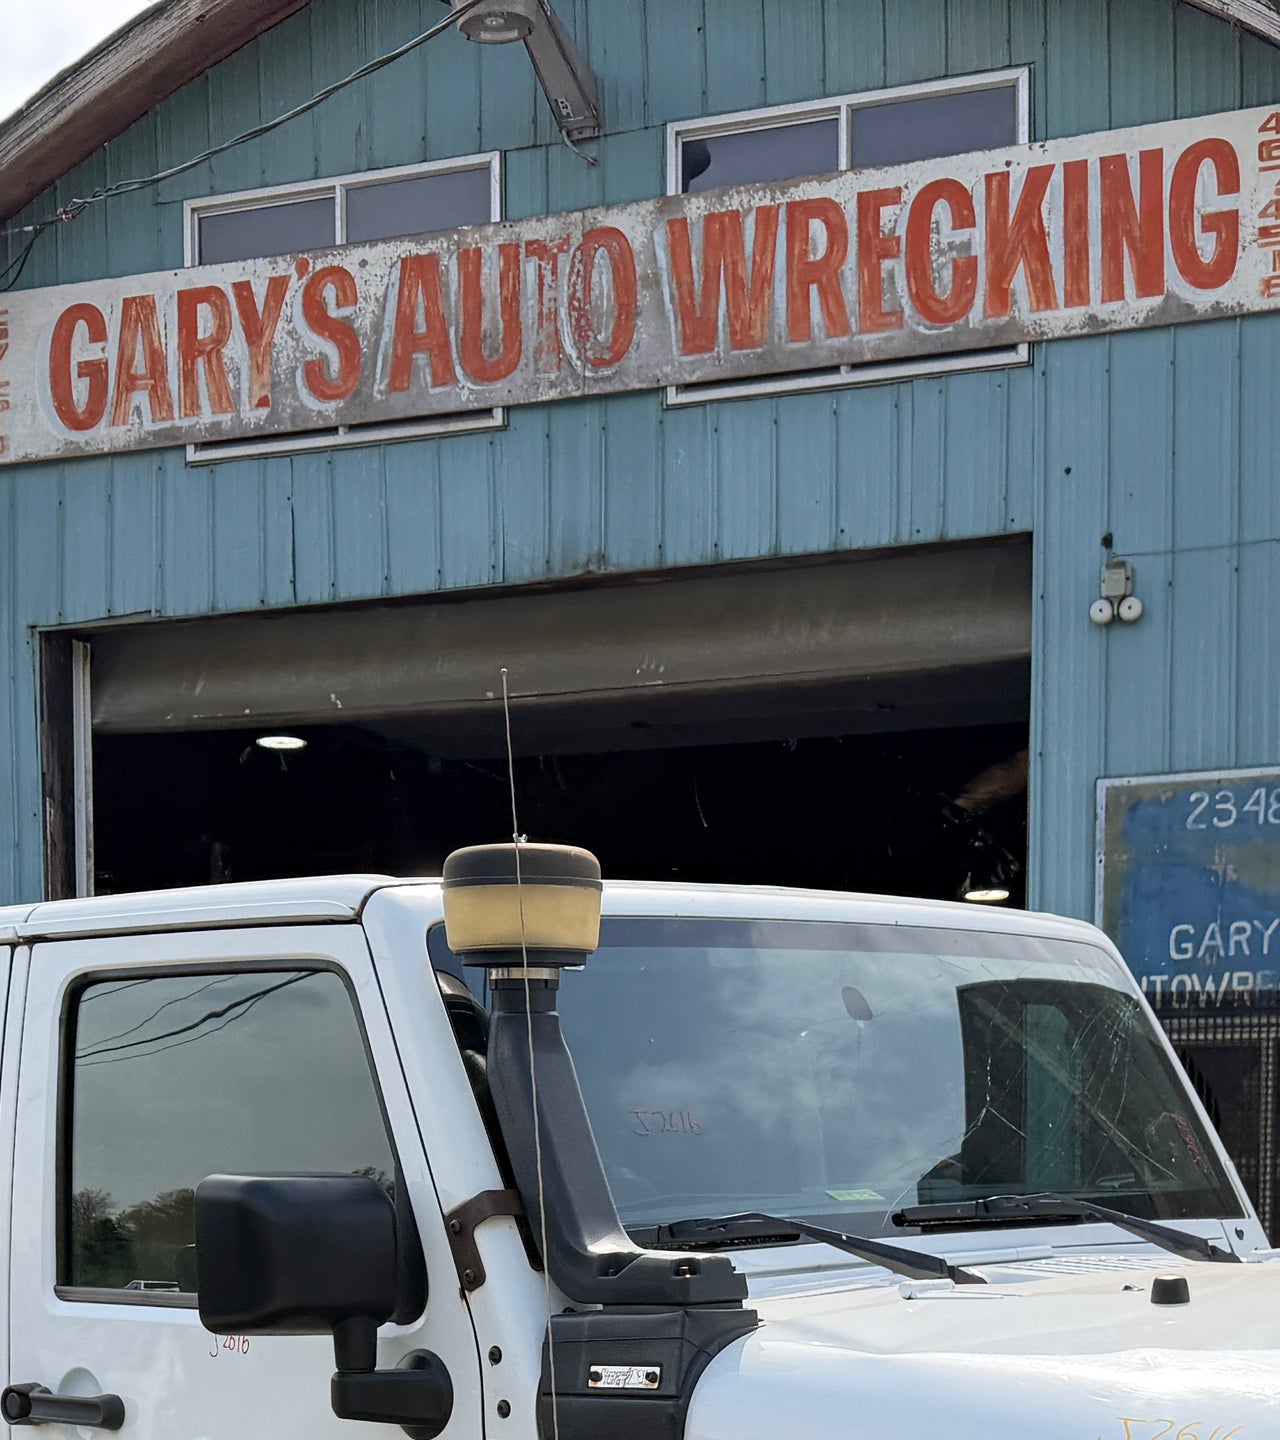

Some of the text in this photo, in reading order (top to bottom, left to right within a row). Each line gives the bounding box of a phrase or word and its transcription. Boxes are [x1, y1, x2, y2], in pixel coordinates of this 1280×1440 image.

[48, 137, 1241, 432] GARY'S AUTO WRECKING
